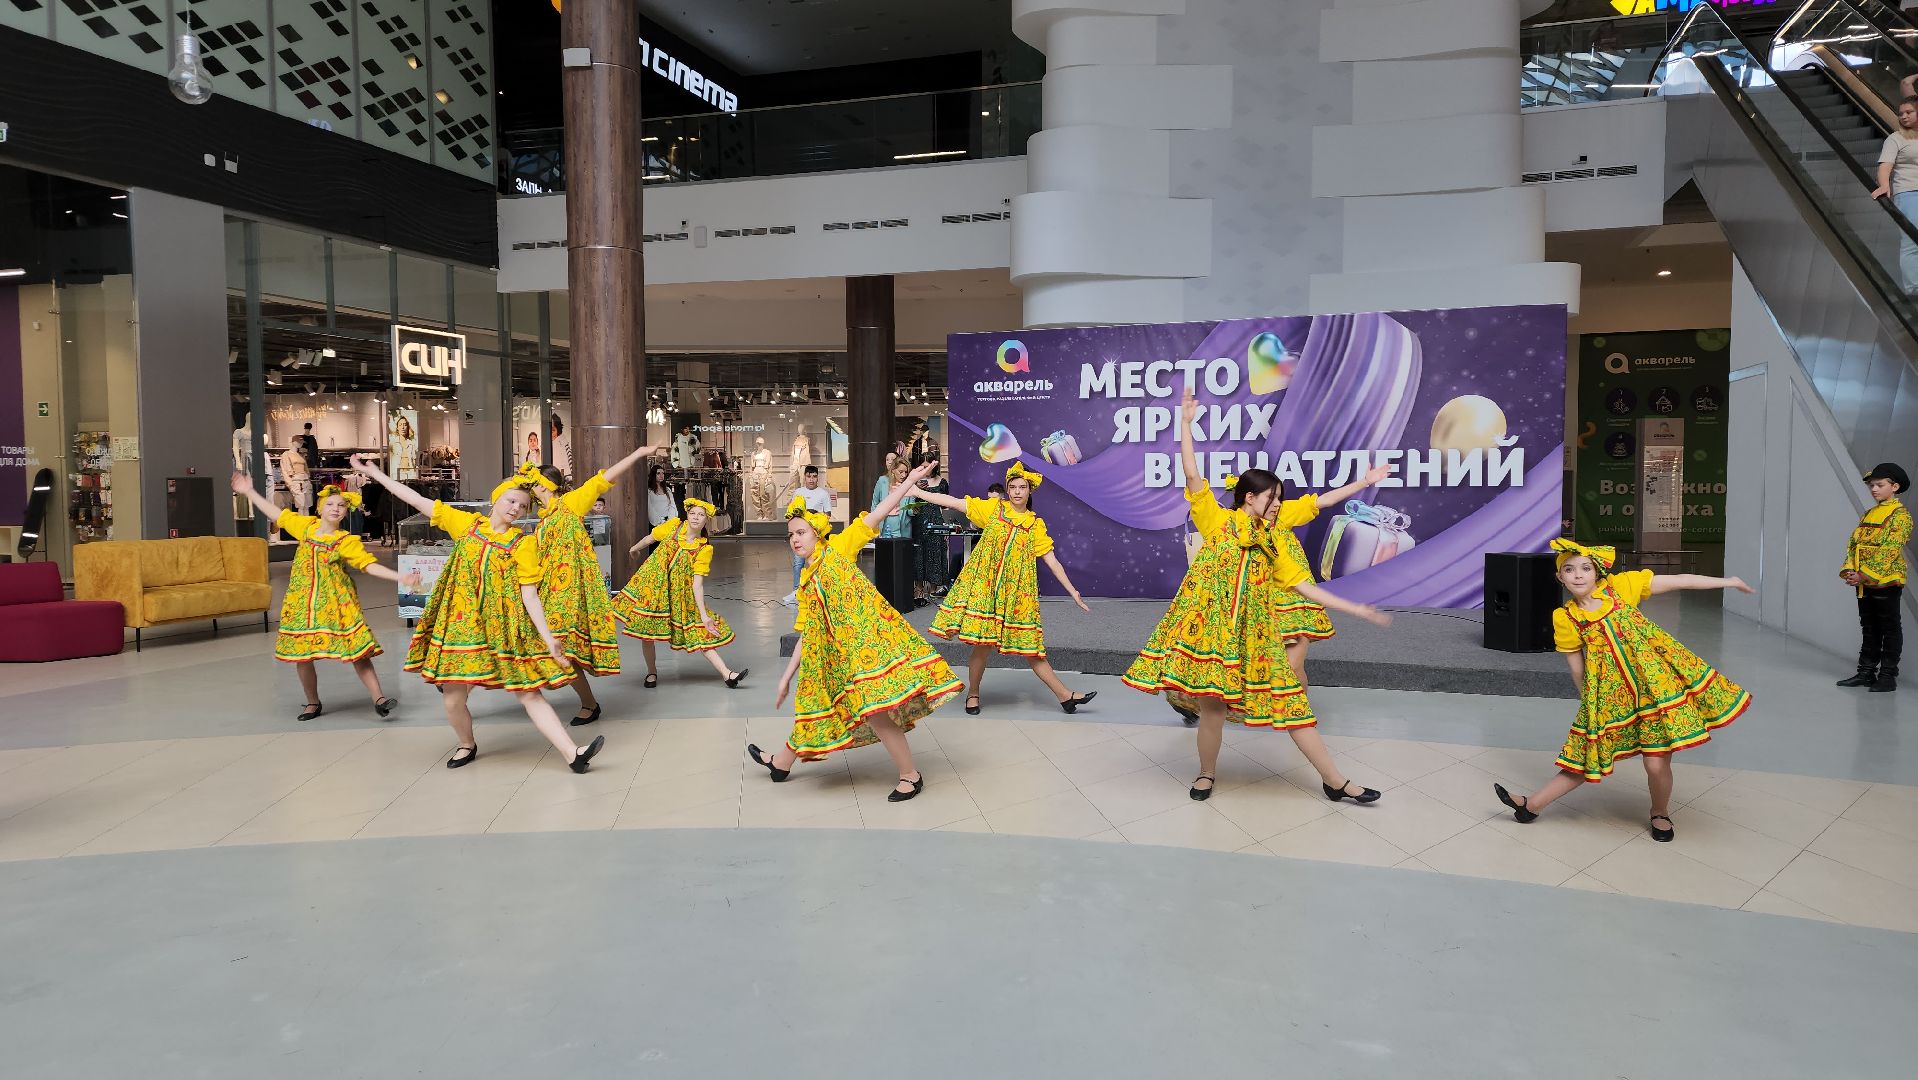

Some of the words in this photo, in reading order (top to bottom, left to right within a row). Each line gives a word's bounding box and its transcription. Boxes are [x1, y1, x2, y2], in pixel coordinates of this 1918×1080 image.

[653, 47, 738, 117] cinema
[1635, 356, 1696, 366] акварель
[1079, 357, 1240, 399] МЕСТО
[974, 379, 1054, 395] акварель
[1112, 403, 1277, 443] ЯРКИХ
[1, 446, 35, 455] ТОВАРЫ
[15, 457, 40, 467] ДОМА
[1600, 504, 1613, 516] и
